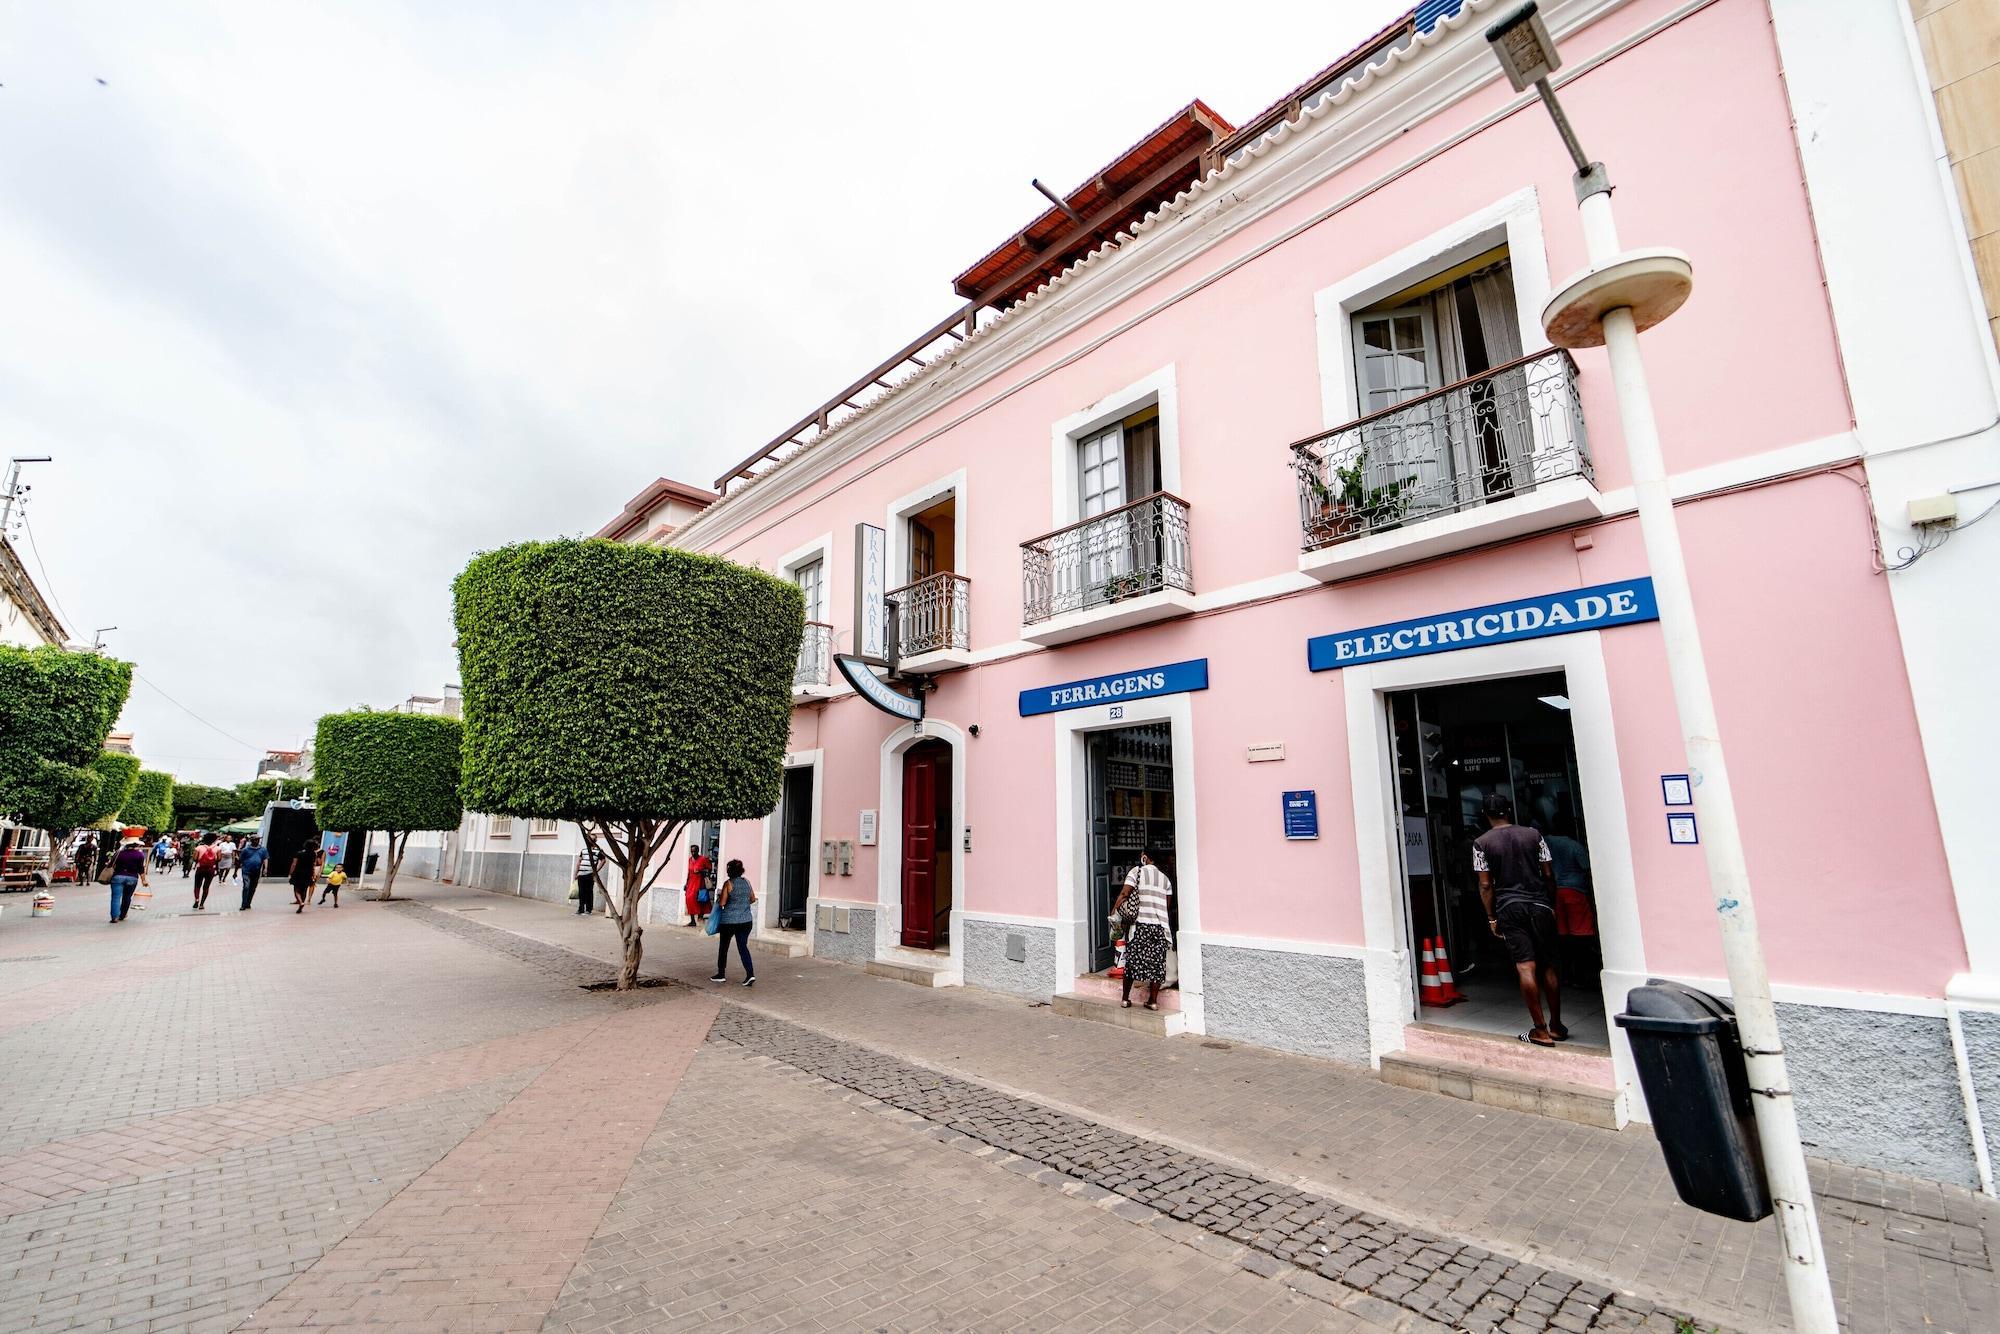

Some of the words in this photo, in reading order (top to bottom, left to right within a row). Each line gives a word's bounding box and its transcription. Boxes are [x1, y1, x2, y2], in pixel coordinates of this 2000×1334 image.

[869, 528, 879, 586] PRAIA
[866, 592, 879, 651] MARIA
[1334, 589, 1639, 661] ELECTRICIDADE
[858, 670, 913, 715] POUSADA
[1050, 672, 1166, 706] FERRAGENS
[1110, 707, 1122, 718] 28
[1464, 764, 1481, 772] LIFE
